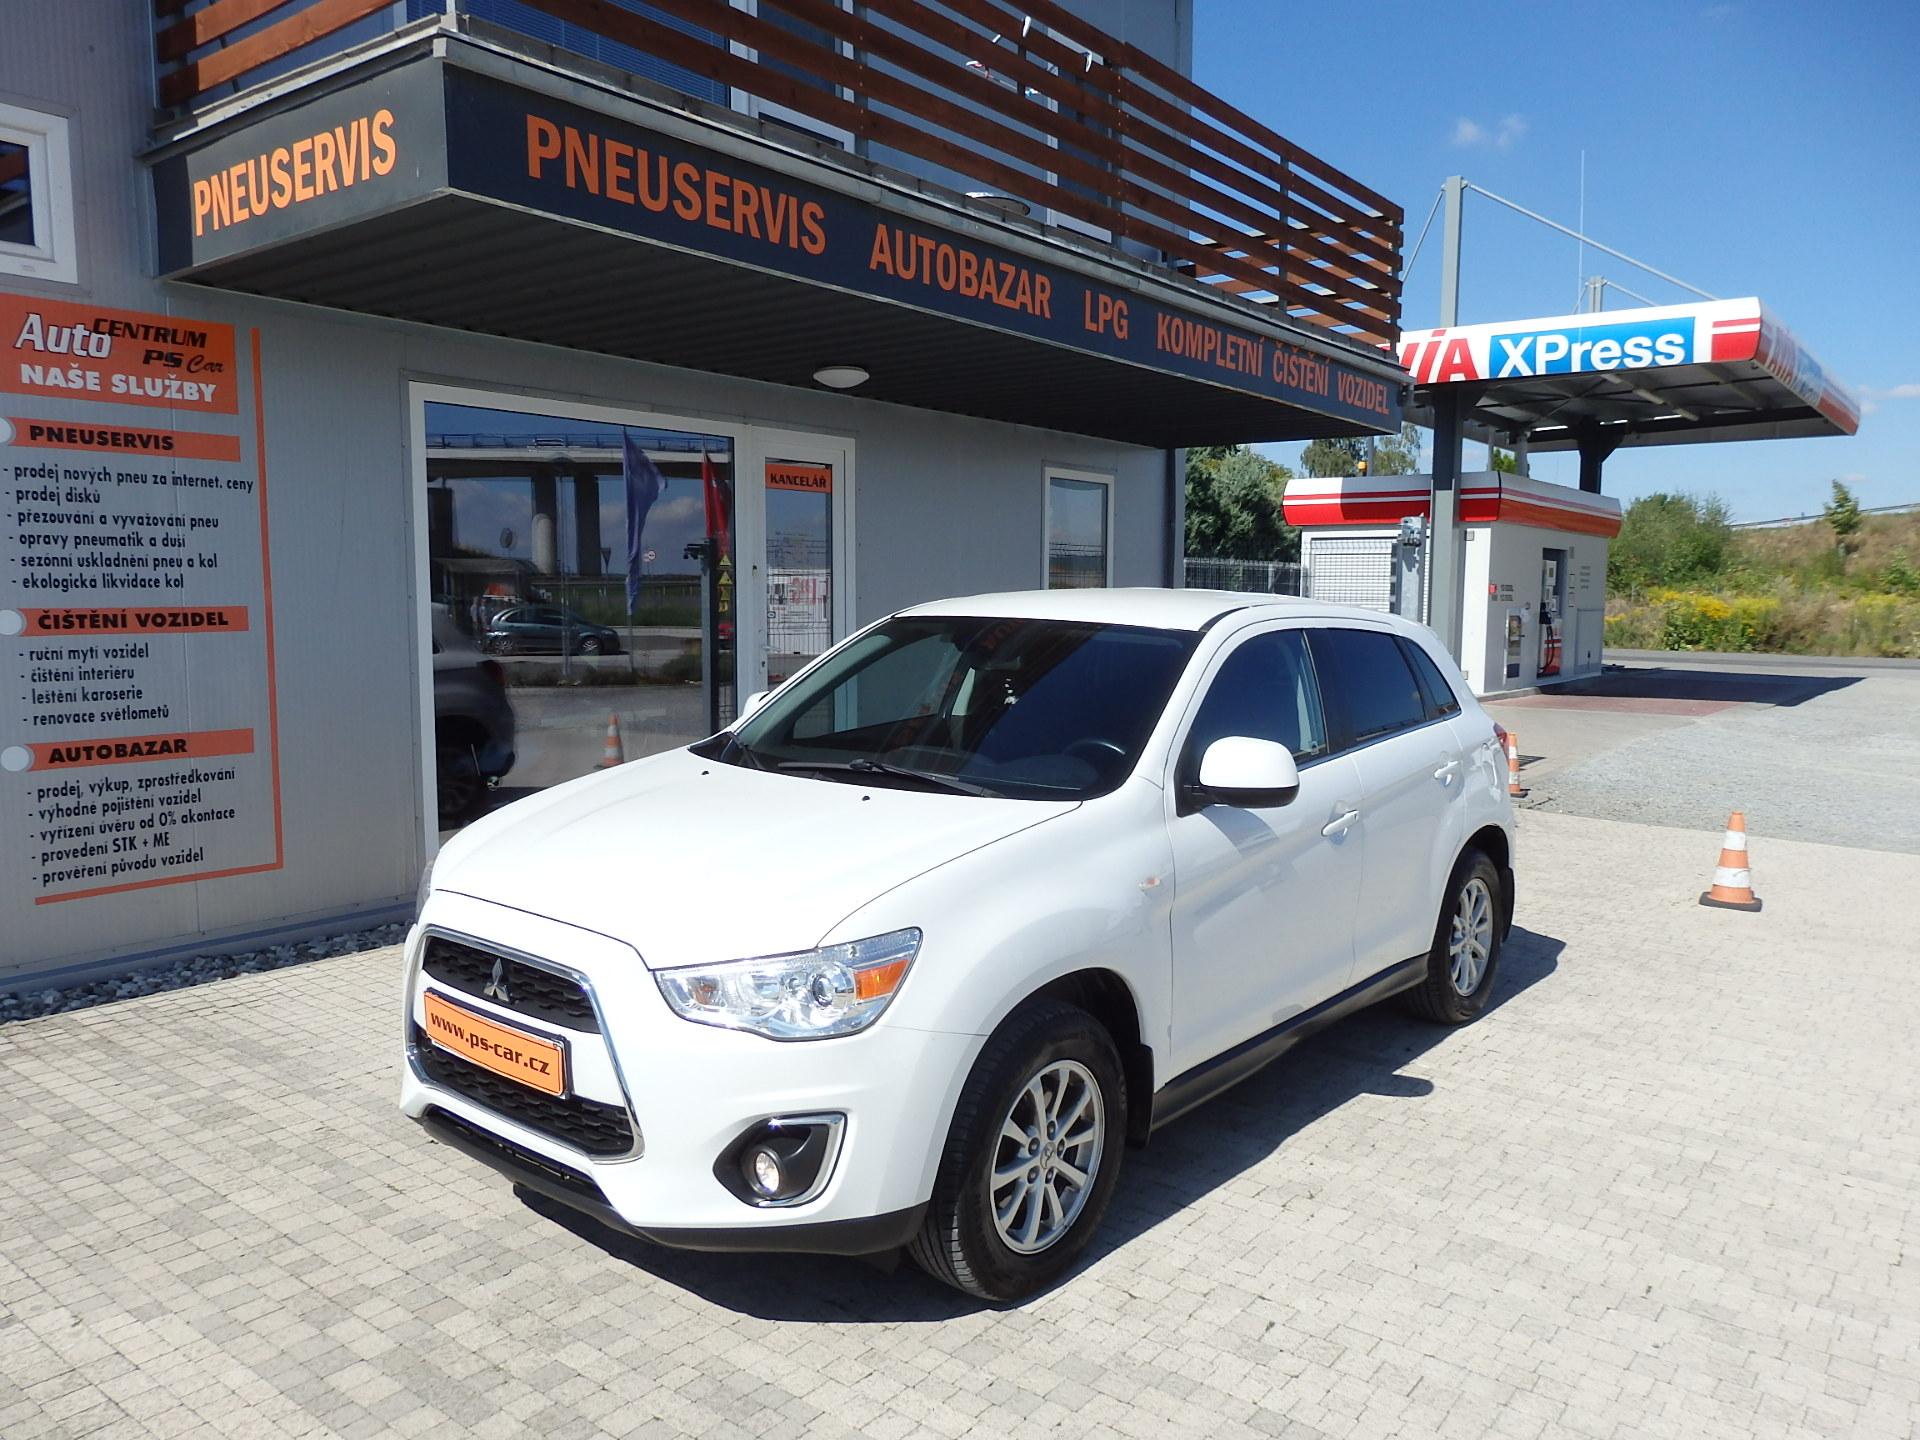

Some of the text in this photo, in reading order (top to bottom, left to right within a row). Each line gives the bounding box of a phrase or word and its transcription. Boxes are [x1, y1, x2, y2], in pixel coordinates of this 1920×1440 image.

[193, 108, 396, 237] PNEUSERVIS
[526, 113, 1390, 415] PNEUSERVIS AUTOBAZAR LPG KOMPLETNÍ ČIŠTĚNÍ VOZIDEL
[14, 312, 112, 359] Auto
[93, 318, 207, 348] CENTRUM
[143, 350, 224, 374] PS Car
[1498, 332, 1686, 378] XPress
[20, 363, 216, 402] NAŠE SLUŽBY
[30, 425, 174, 450] PNEUSERVIS
[14, 462, 254, 494] prodej nových pneu za internet. ceny
[16, 485, 101, 506] prodej disků
[17, 509, 219, 531] přezouvání a vyvažování pneu
[19, 531, 186, 549] opravy pneumatik a duší
[21, 551, 217, 571] sezónní uskladnění pneu a kol
[23, 572, 184, 593] ekologická likvidace kol
[38, 609, 228, 630] ČIŠTĚNÍ VOZIDEL
[30, 642, 149, 663] ruční mytí vozidel
[31, 665, 134, 682] čištění interiéru
[32, 685, 143, 704] leštění karoserie
[34, 704, 169, 726] renovace světlometů
[48, 738, 188, 764] AUTOBAZAR
[37, 766, 235, 802] prodej, výkup, zprostředkování
[39, 800, 97, 823] výhodné
[158, 788, 201, 806] vozidel
[140, 813, 154, 829] od
[159, 810, 177, 826] 0%
[181, 807, 235, 825] akontace
[41, 842, 108, 866] provedení
[113, 835, 137, 853] STK
[154, 831, 170, 848] ME
[42, 847, 204, 888] prověření původu vozidel
[430, 1012, 551, 1076] www.ps-car.cz
